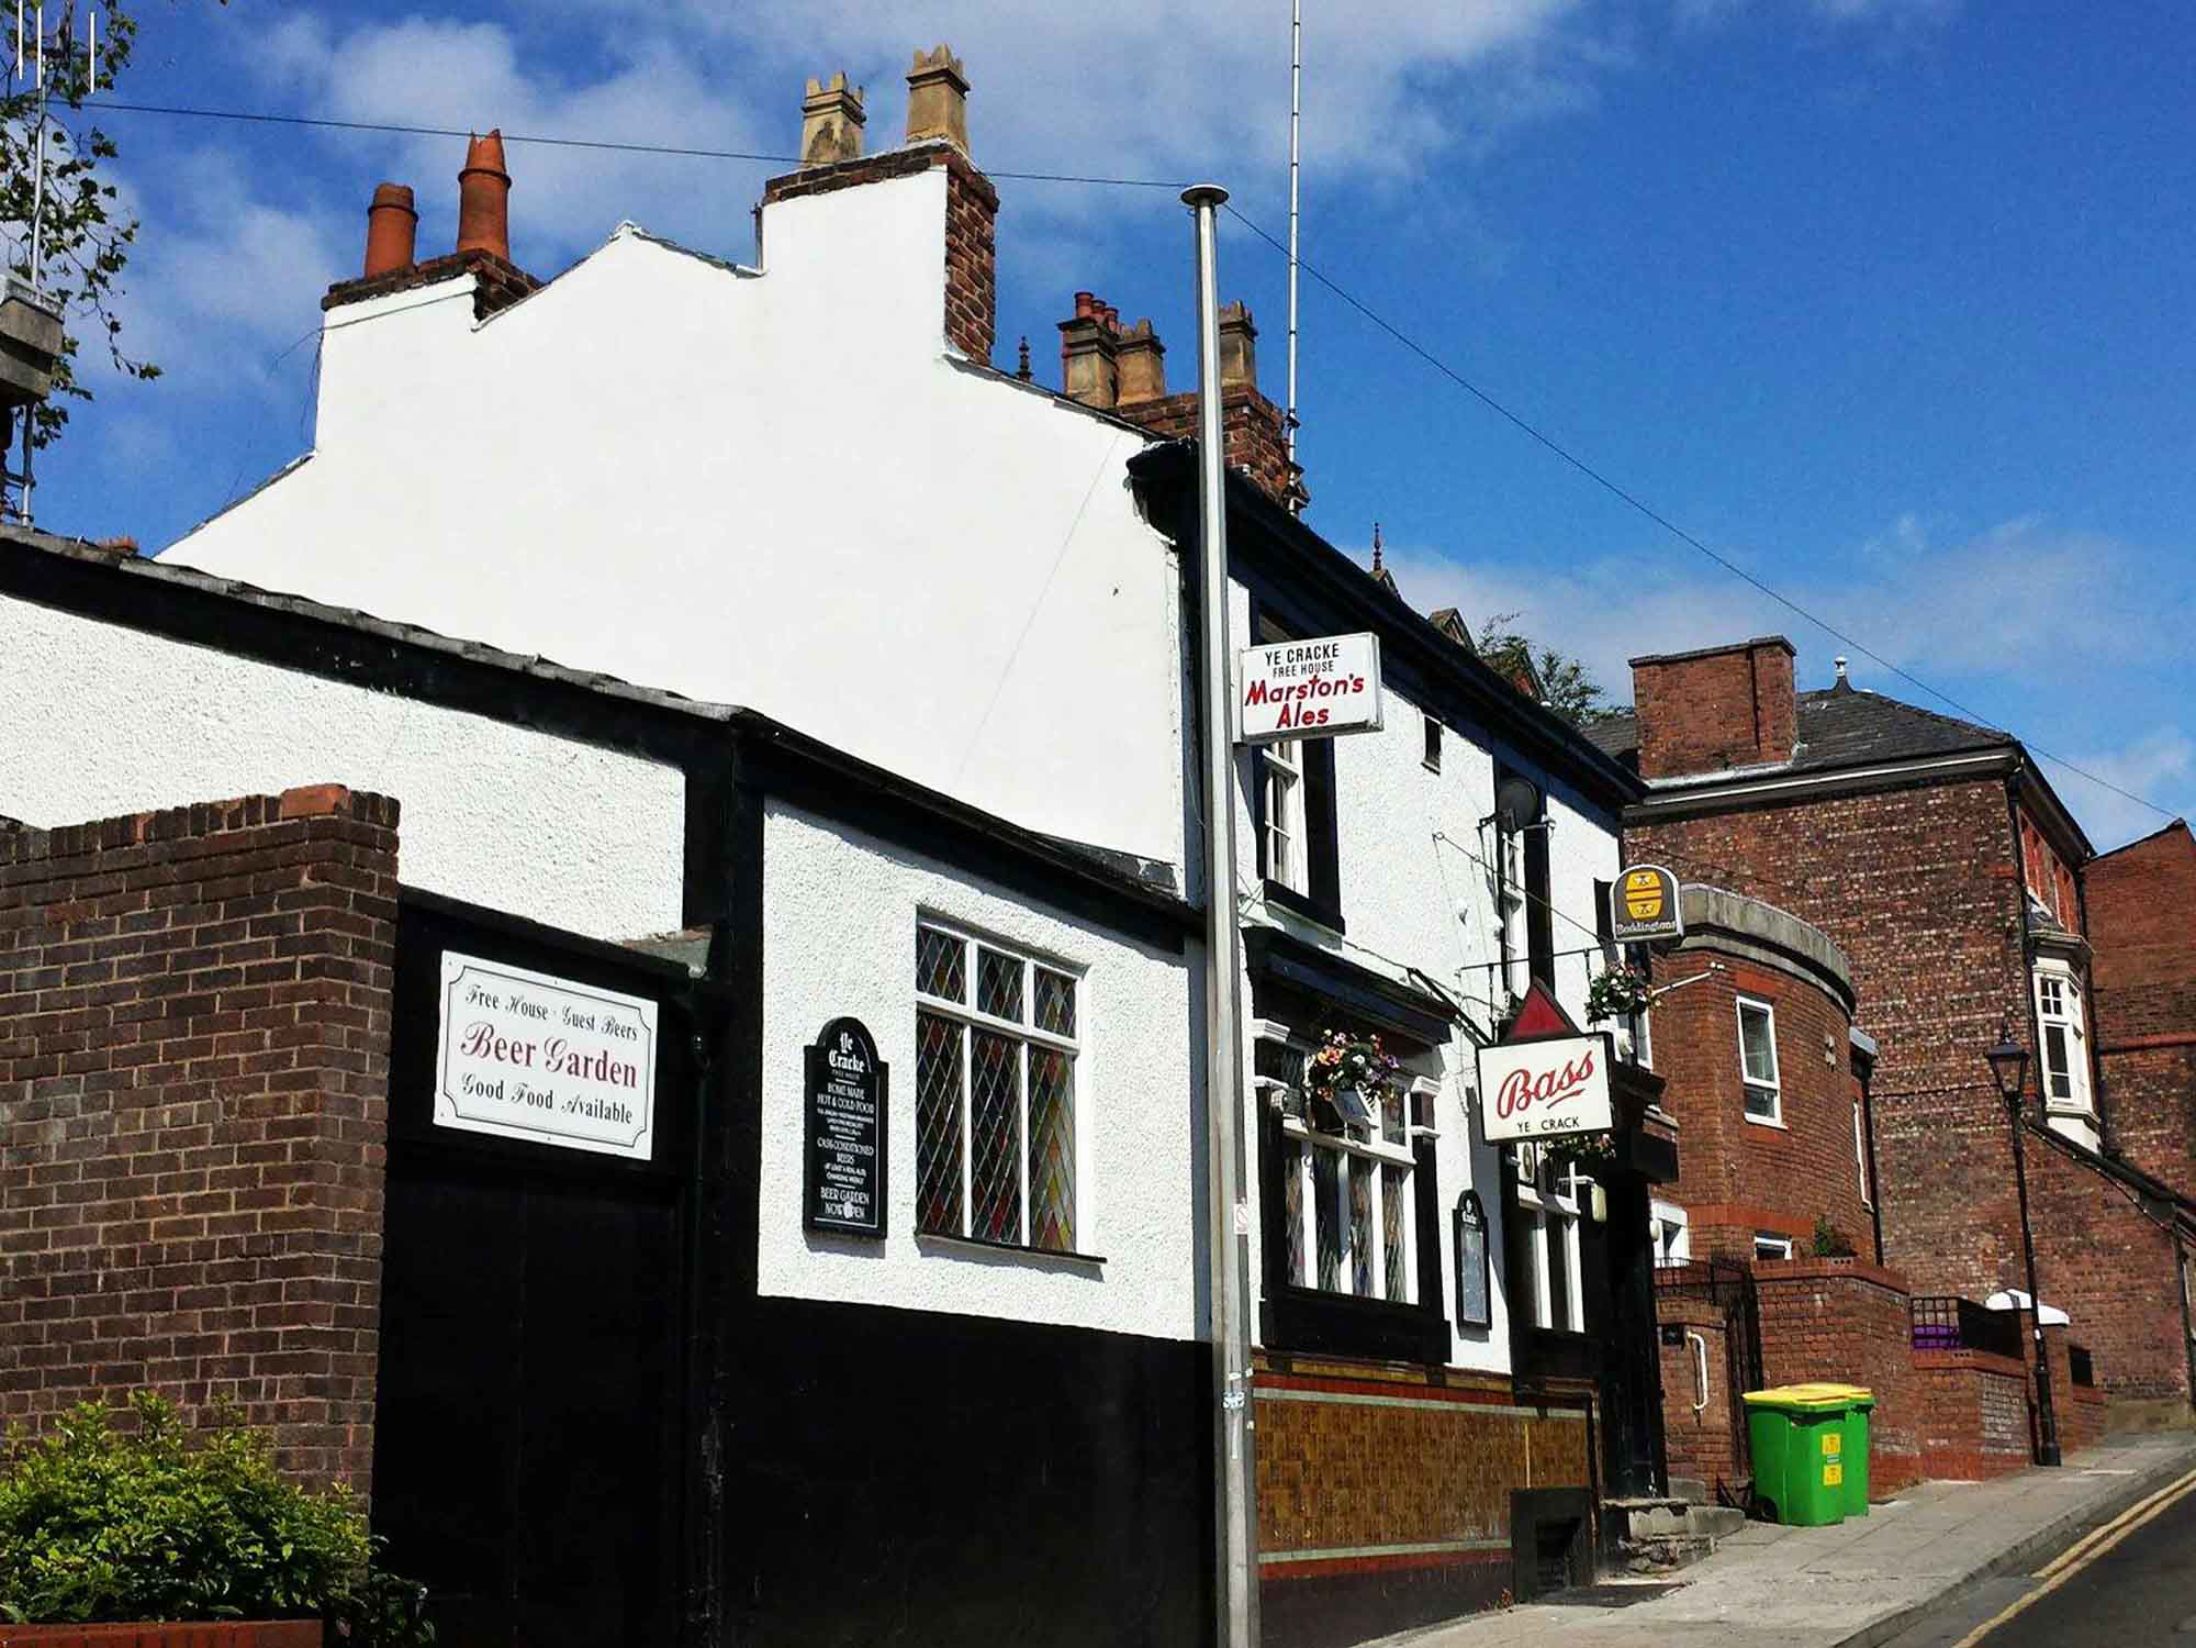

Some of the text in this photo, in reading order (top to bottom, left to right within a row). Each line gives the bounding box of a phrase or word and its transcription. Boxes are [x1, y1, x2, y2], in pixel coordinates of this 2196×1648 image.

[1265, 643, 1340, 666] YE CRACKE
[1273, 660, 1334, 678] FREE HOUSE
[1245, 673, 1364, 706] Marston's
[1276, 701, 1329, 729] Ales
[465, 983, 638, 1041] Free House Guest Beers
[460, 1021, 637, 1088] Beer Garden
[840, 1032, 853, 1054] Ye
[828, 1049, 866, 1073] Cracke
[1497, 1050, 1594, 1119] Bass
[461, 1072, 632, 1124] Good Food Available
[1517, 1116, 1580, 1133] YE CRACK
[820, 1187, 869, 1205] BEER GARDEN
